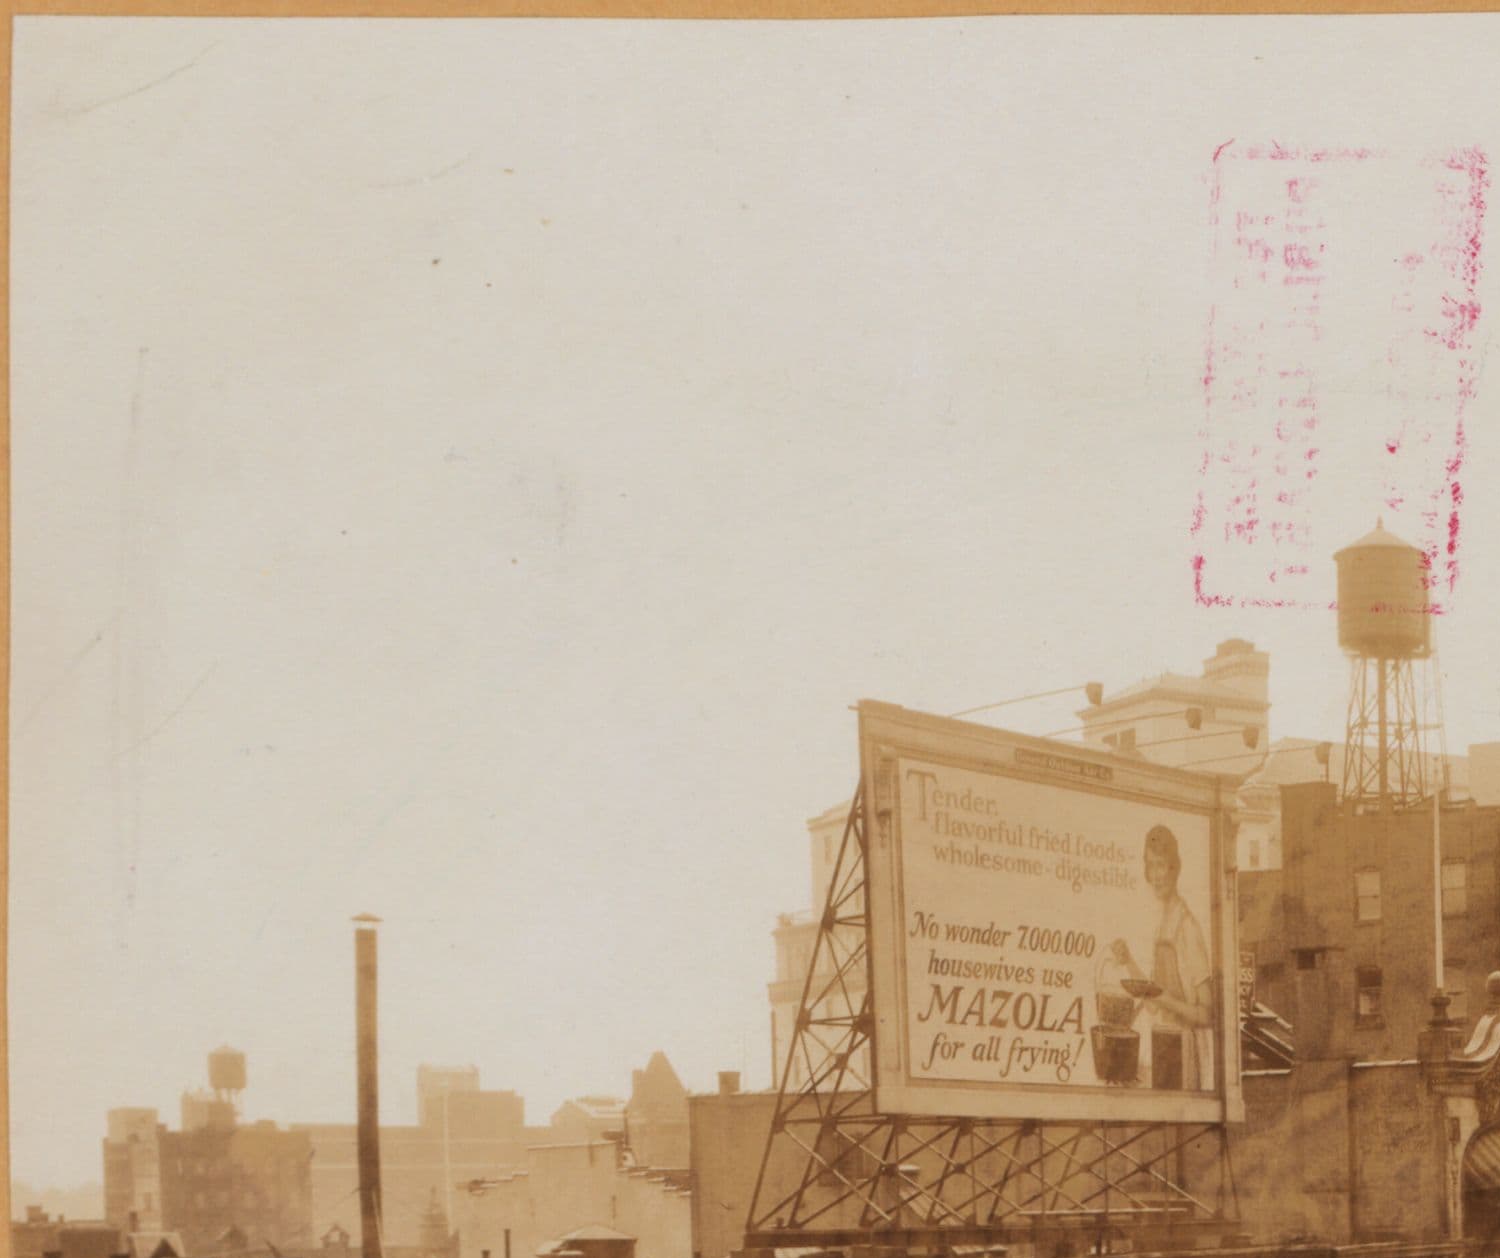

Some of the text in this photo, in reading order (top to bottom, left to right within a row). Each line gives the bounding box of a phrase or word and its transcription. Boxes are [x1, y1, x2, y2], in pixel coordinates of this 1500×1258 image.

[933, 810, 1024, 850] flavorful
[1028, 826, 1073, 856] fried
[1055, 857, 1138, 893] digestible
[909, 910, 940, 941] No
[945, 921, 1011, 948] wonder
[927, 949, 1074, 989] housewives use
[916, 983, 1085, 1035] MAZOLA
[921, 1032, 1085, 1083] for all frying!
